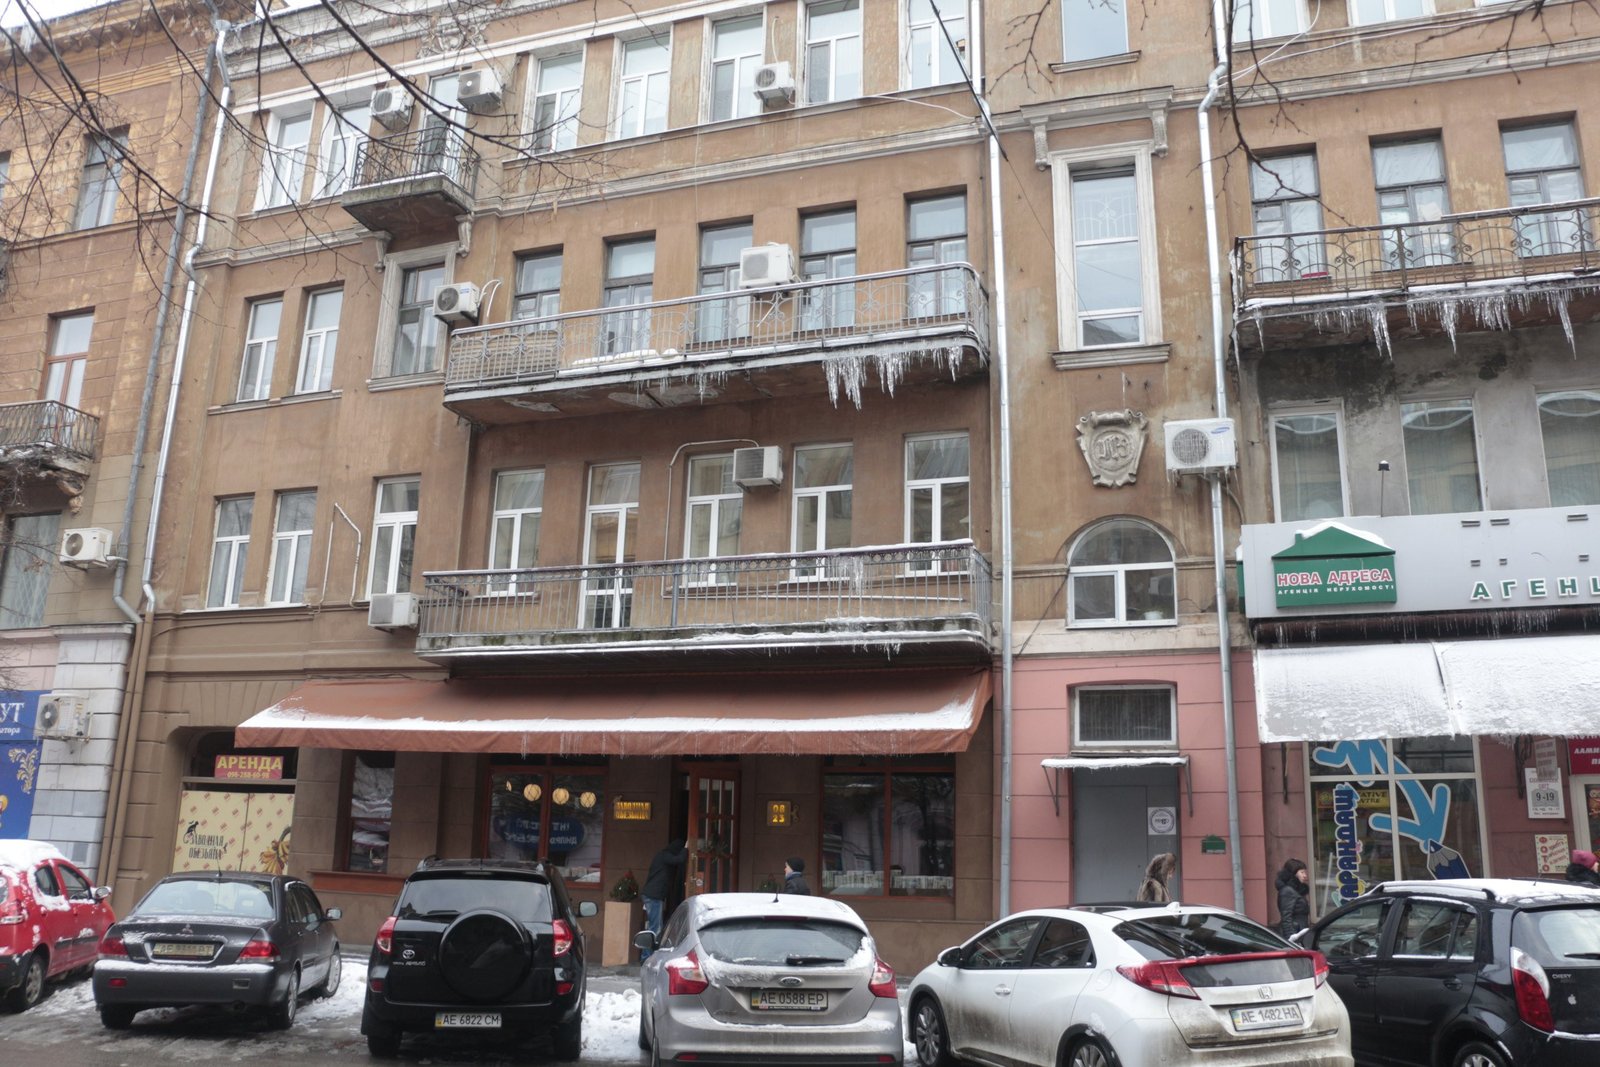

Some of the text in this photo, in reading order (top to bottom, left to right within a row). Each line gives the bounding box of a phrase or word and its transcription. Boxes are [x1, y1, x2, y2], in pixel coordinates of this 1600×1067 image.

[1277, 568, 1393, 587] НОВА АДРЕСА
[1326, 584, 1394, 593] НЕРУХОМОСТІ
[217, 756, 282, 771] АРЕНДА
[760, 992, 825, 1005] AE 0588 EP
[443, 1015, 499, 1025] AE 6822 CM
[1241, 1006, 1299, 1023] AE 1482 HA
